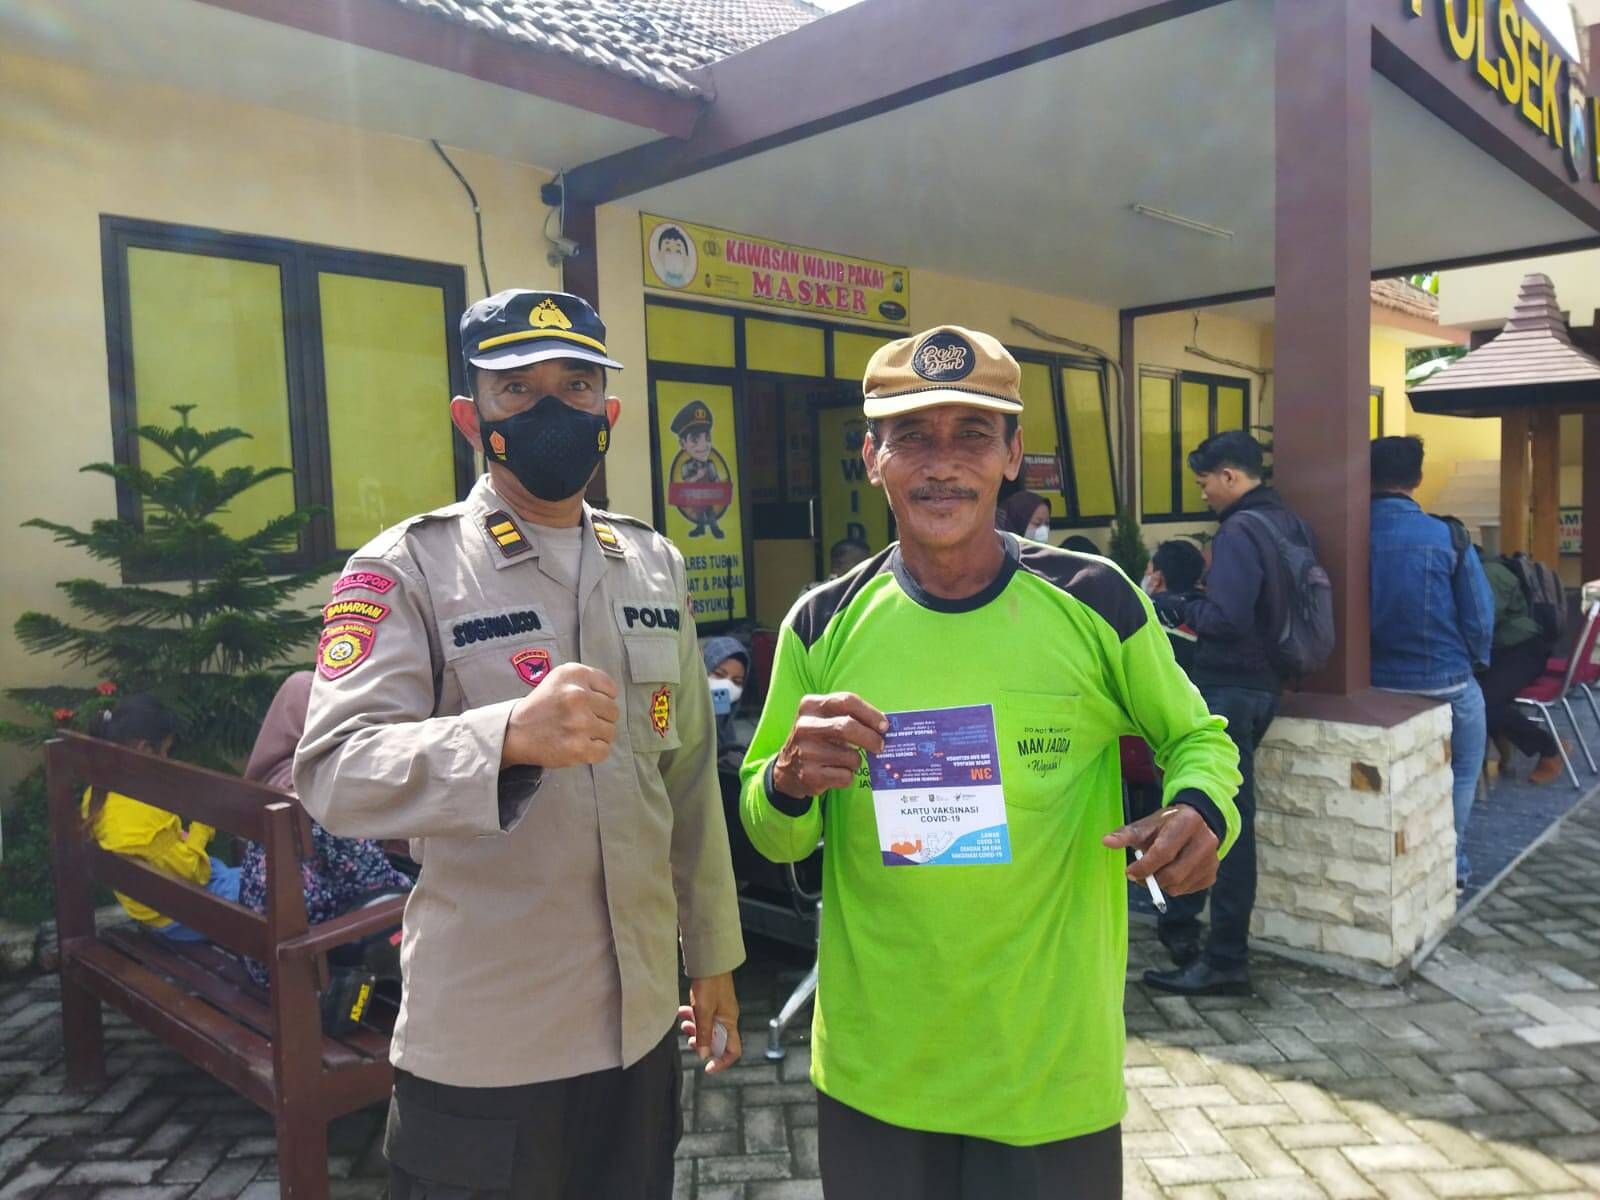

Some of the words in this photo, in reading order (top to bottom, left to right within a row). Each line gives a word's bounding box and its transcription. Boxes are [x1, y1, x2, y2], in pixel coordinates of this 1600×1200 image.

[1409, 0, 1564, 148] OLSEK
[725, 239, 800, 276] KAWASAN
[802, 254, 845, 283] WAJIB
[847, 264, 884, 289] PAKAI
[752, 271, 868, 314] MASKER
[685, 556, 707, 571] LRES
[709, 554, 739, 569] TUBAN
[623, 606, 680, 631] POLRI
[1017, 738, 1044, 756] MAN
[970, 767, 993, 780] 3M
[901, 807, 930, 816] KARTU
[932, 806, 979, 815] VAKSINASI
[920, 815, 961, 823] COVID-19
